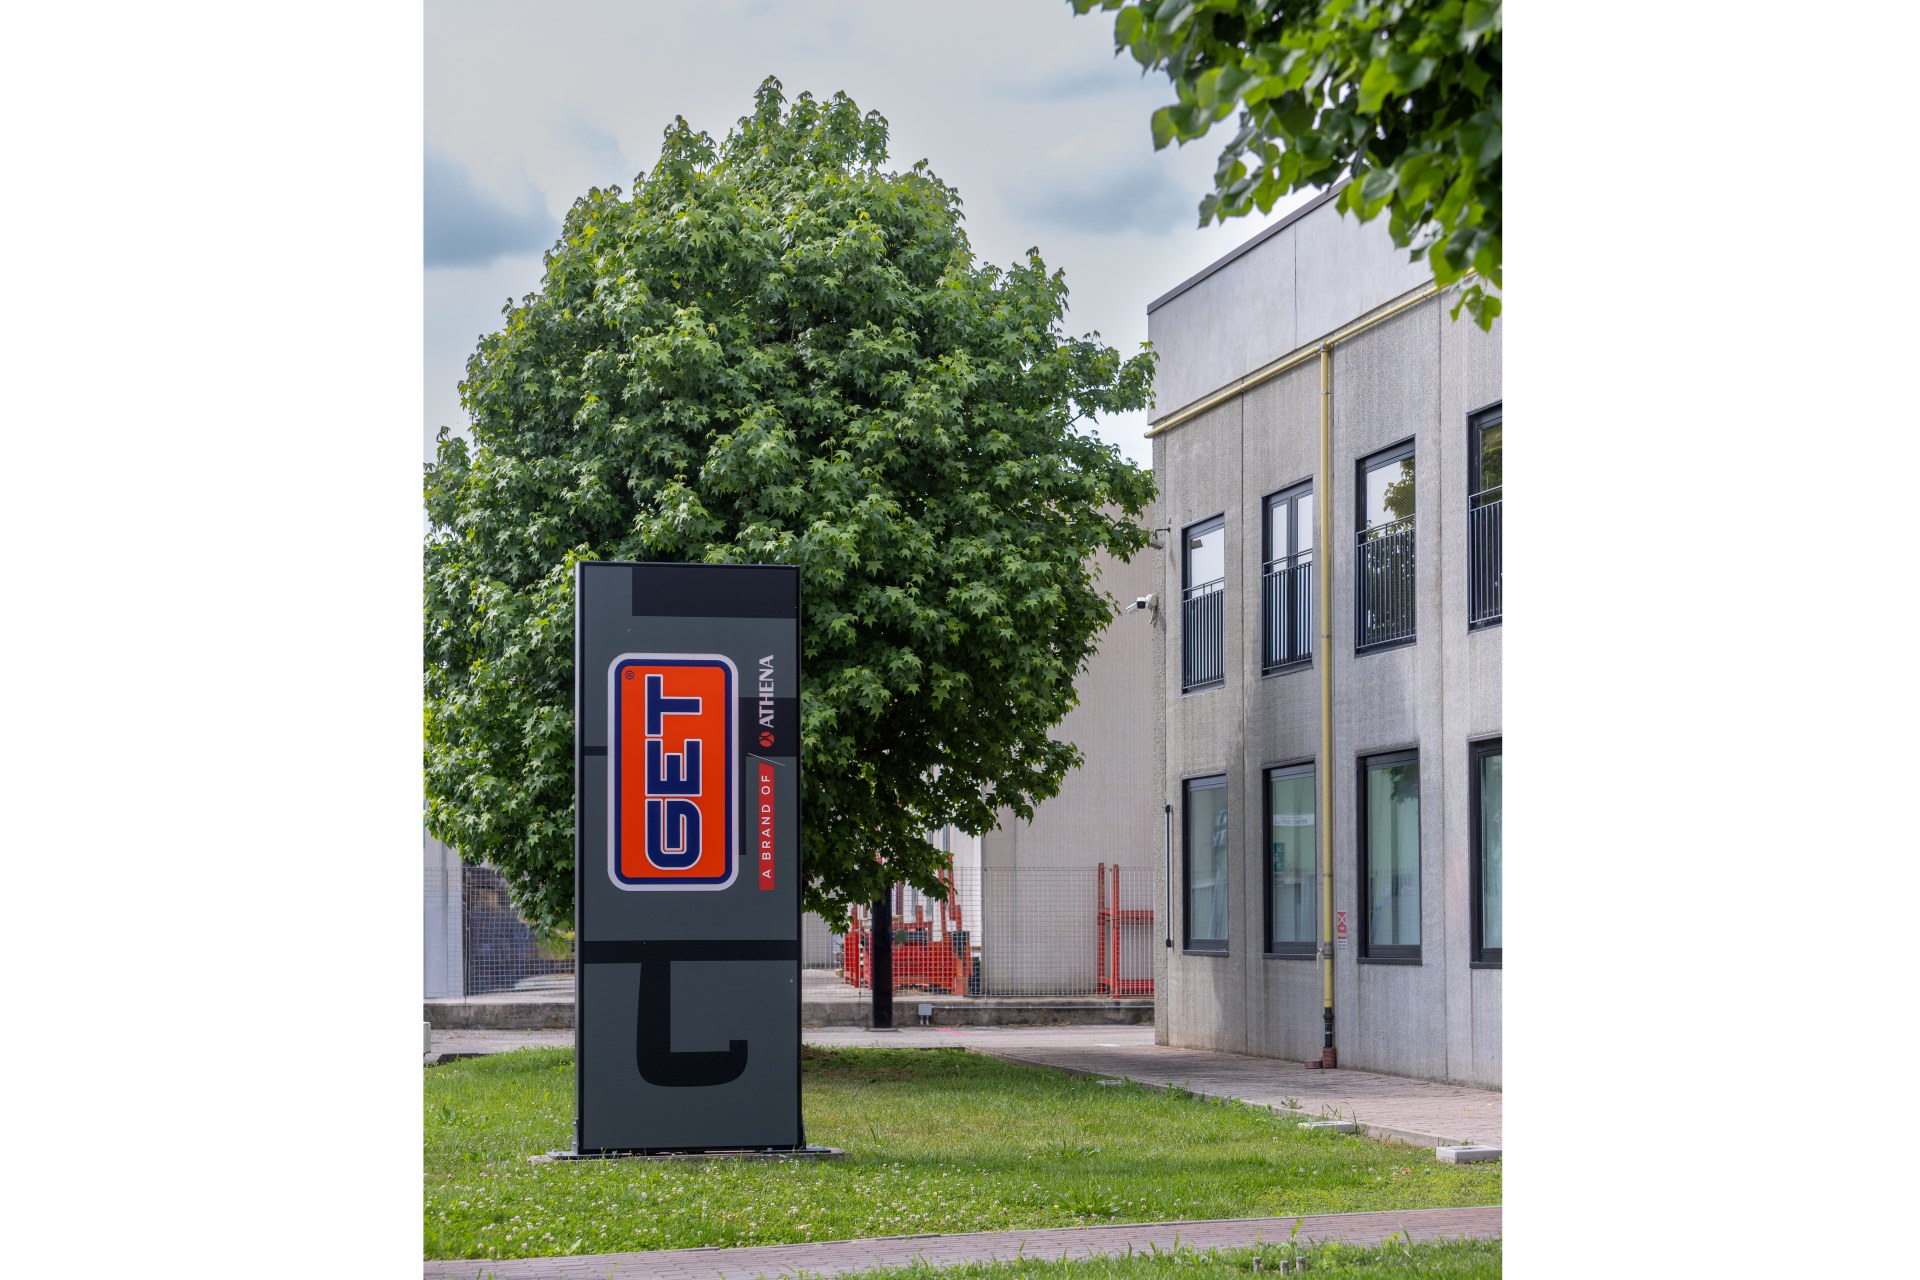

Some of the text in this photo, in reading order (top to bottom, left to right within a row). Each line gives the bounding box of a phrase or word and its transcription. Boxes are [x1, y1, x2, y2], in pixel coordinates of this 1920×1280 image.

[645, 674, 702, 870] GET
[759, 654, 774, 879] A BRAND OF ATHENA
